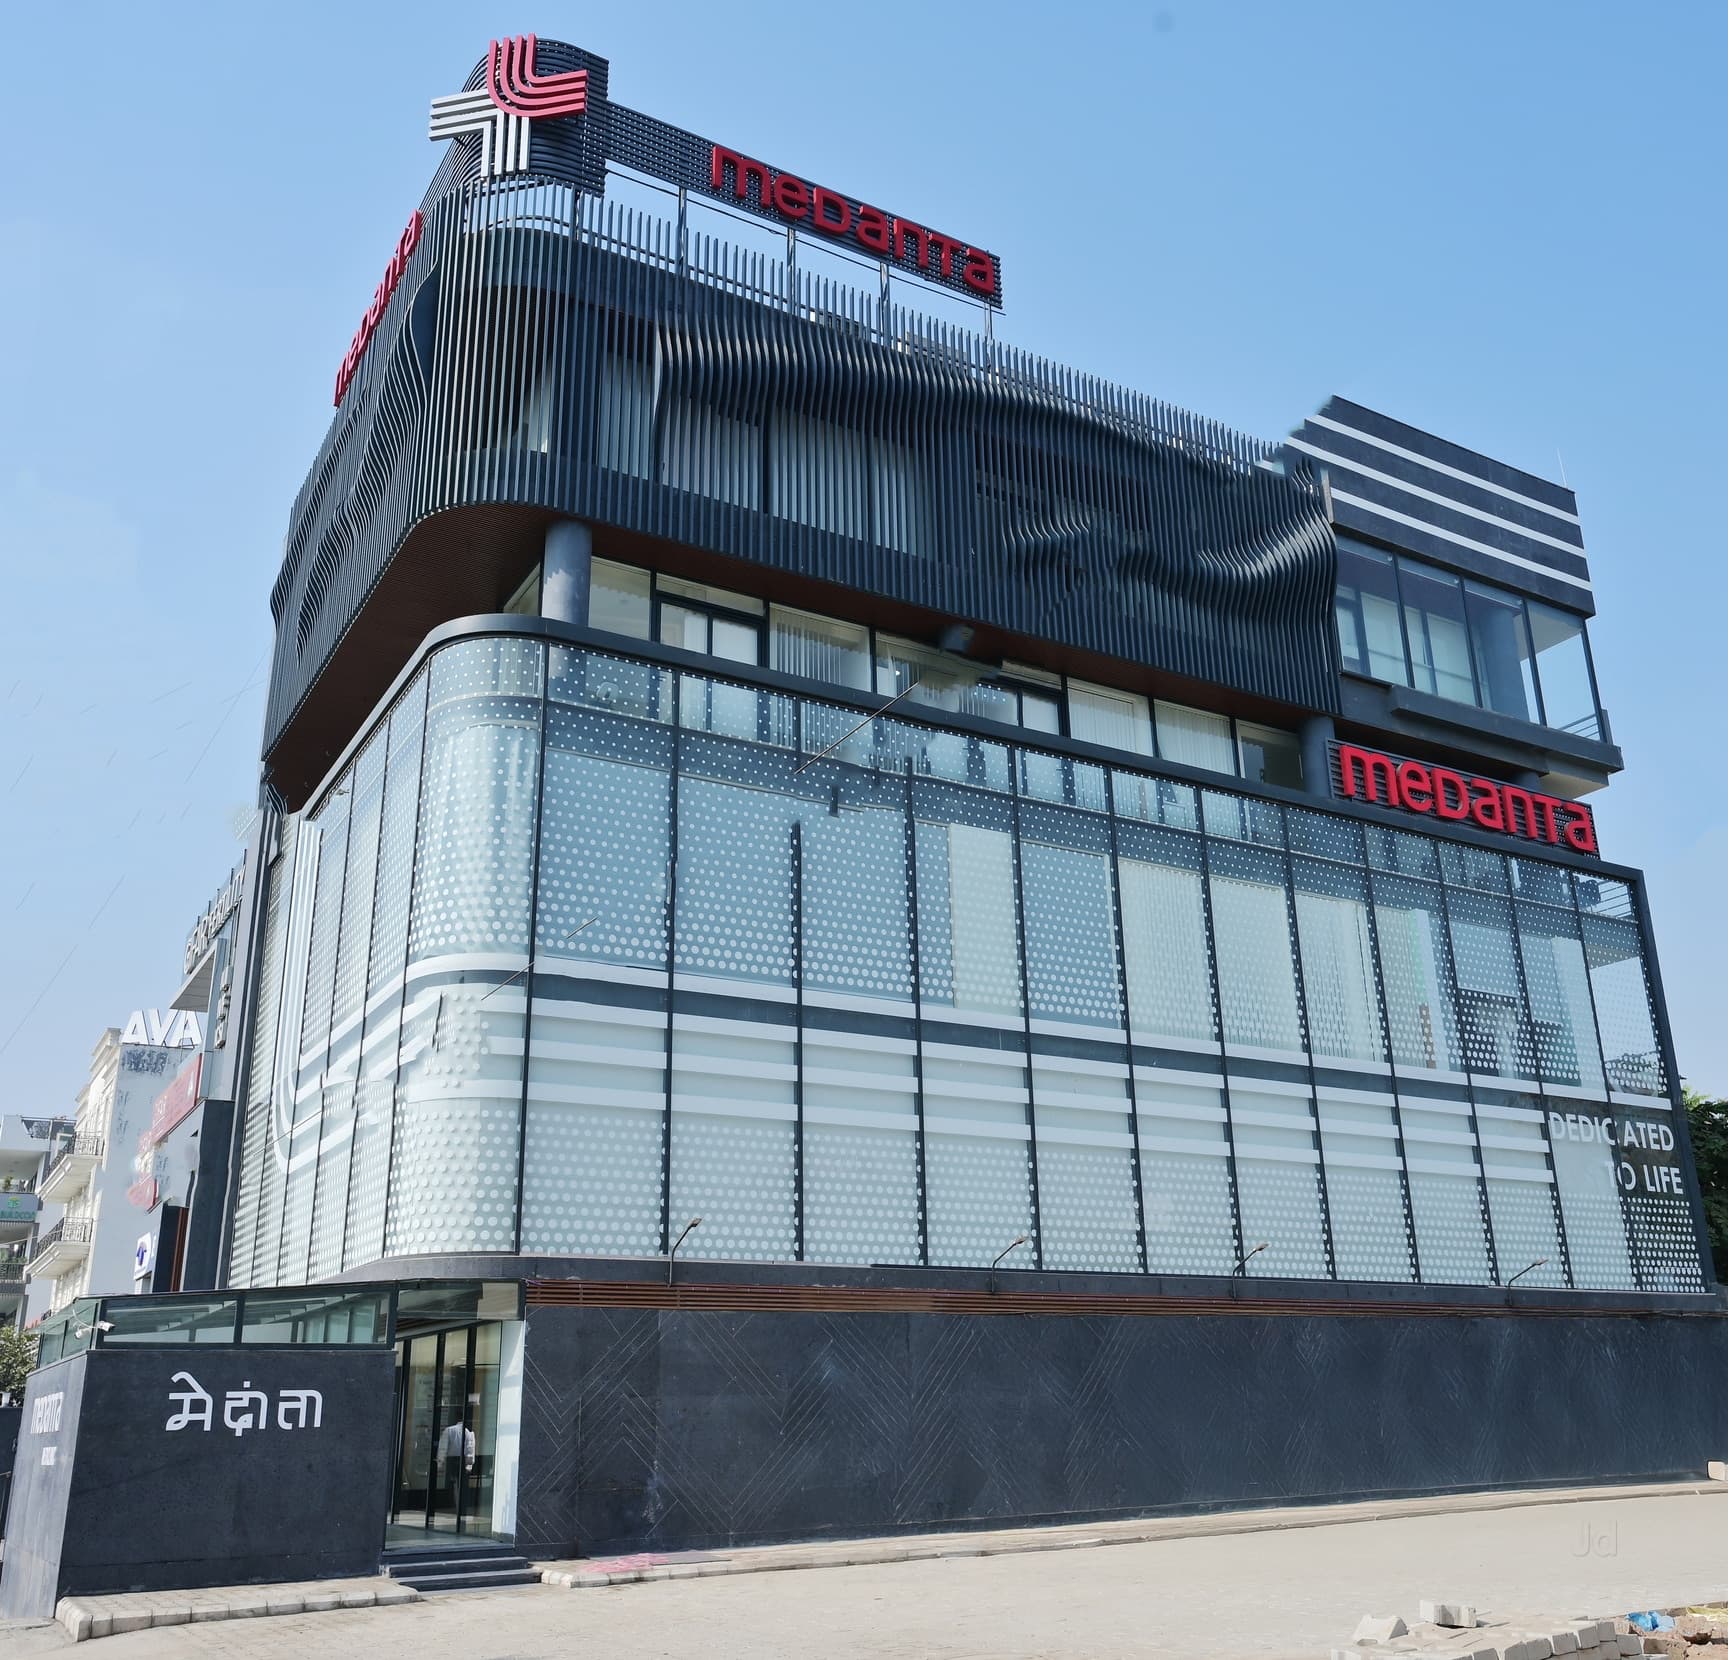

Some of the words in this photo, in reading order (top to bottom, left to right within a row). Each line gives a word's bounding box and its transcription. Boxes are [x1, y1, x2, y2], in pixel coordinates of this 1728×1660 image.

[1548, 1111, 1674, 1151] DEDICATED
[1642, 1164, 1684, 1195] LIFE
[165, 1371, 323, 1437] मेदांता
